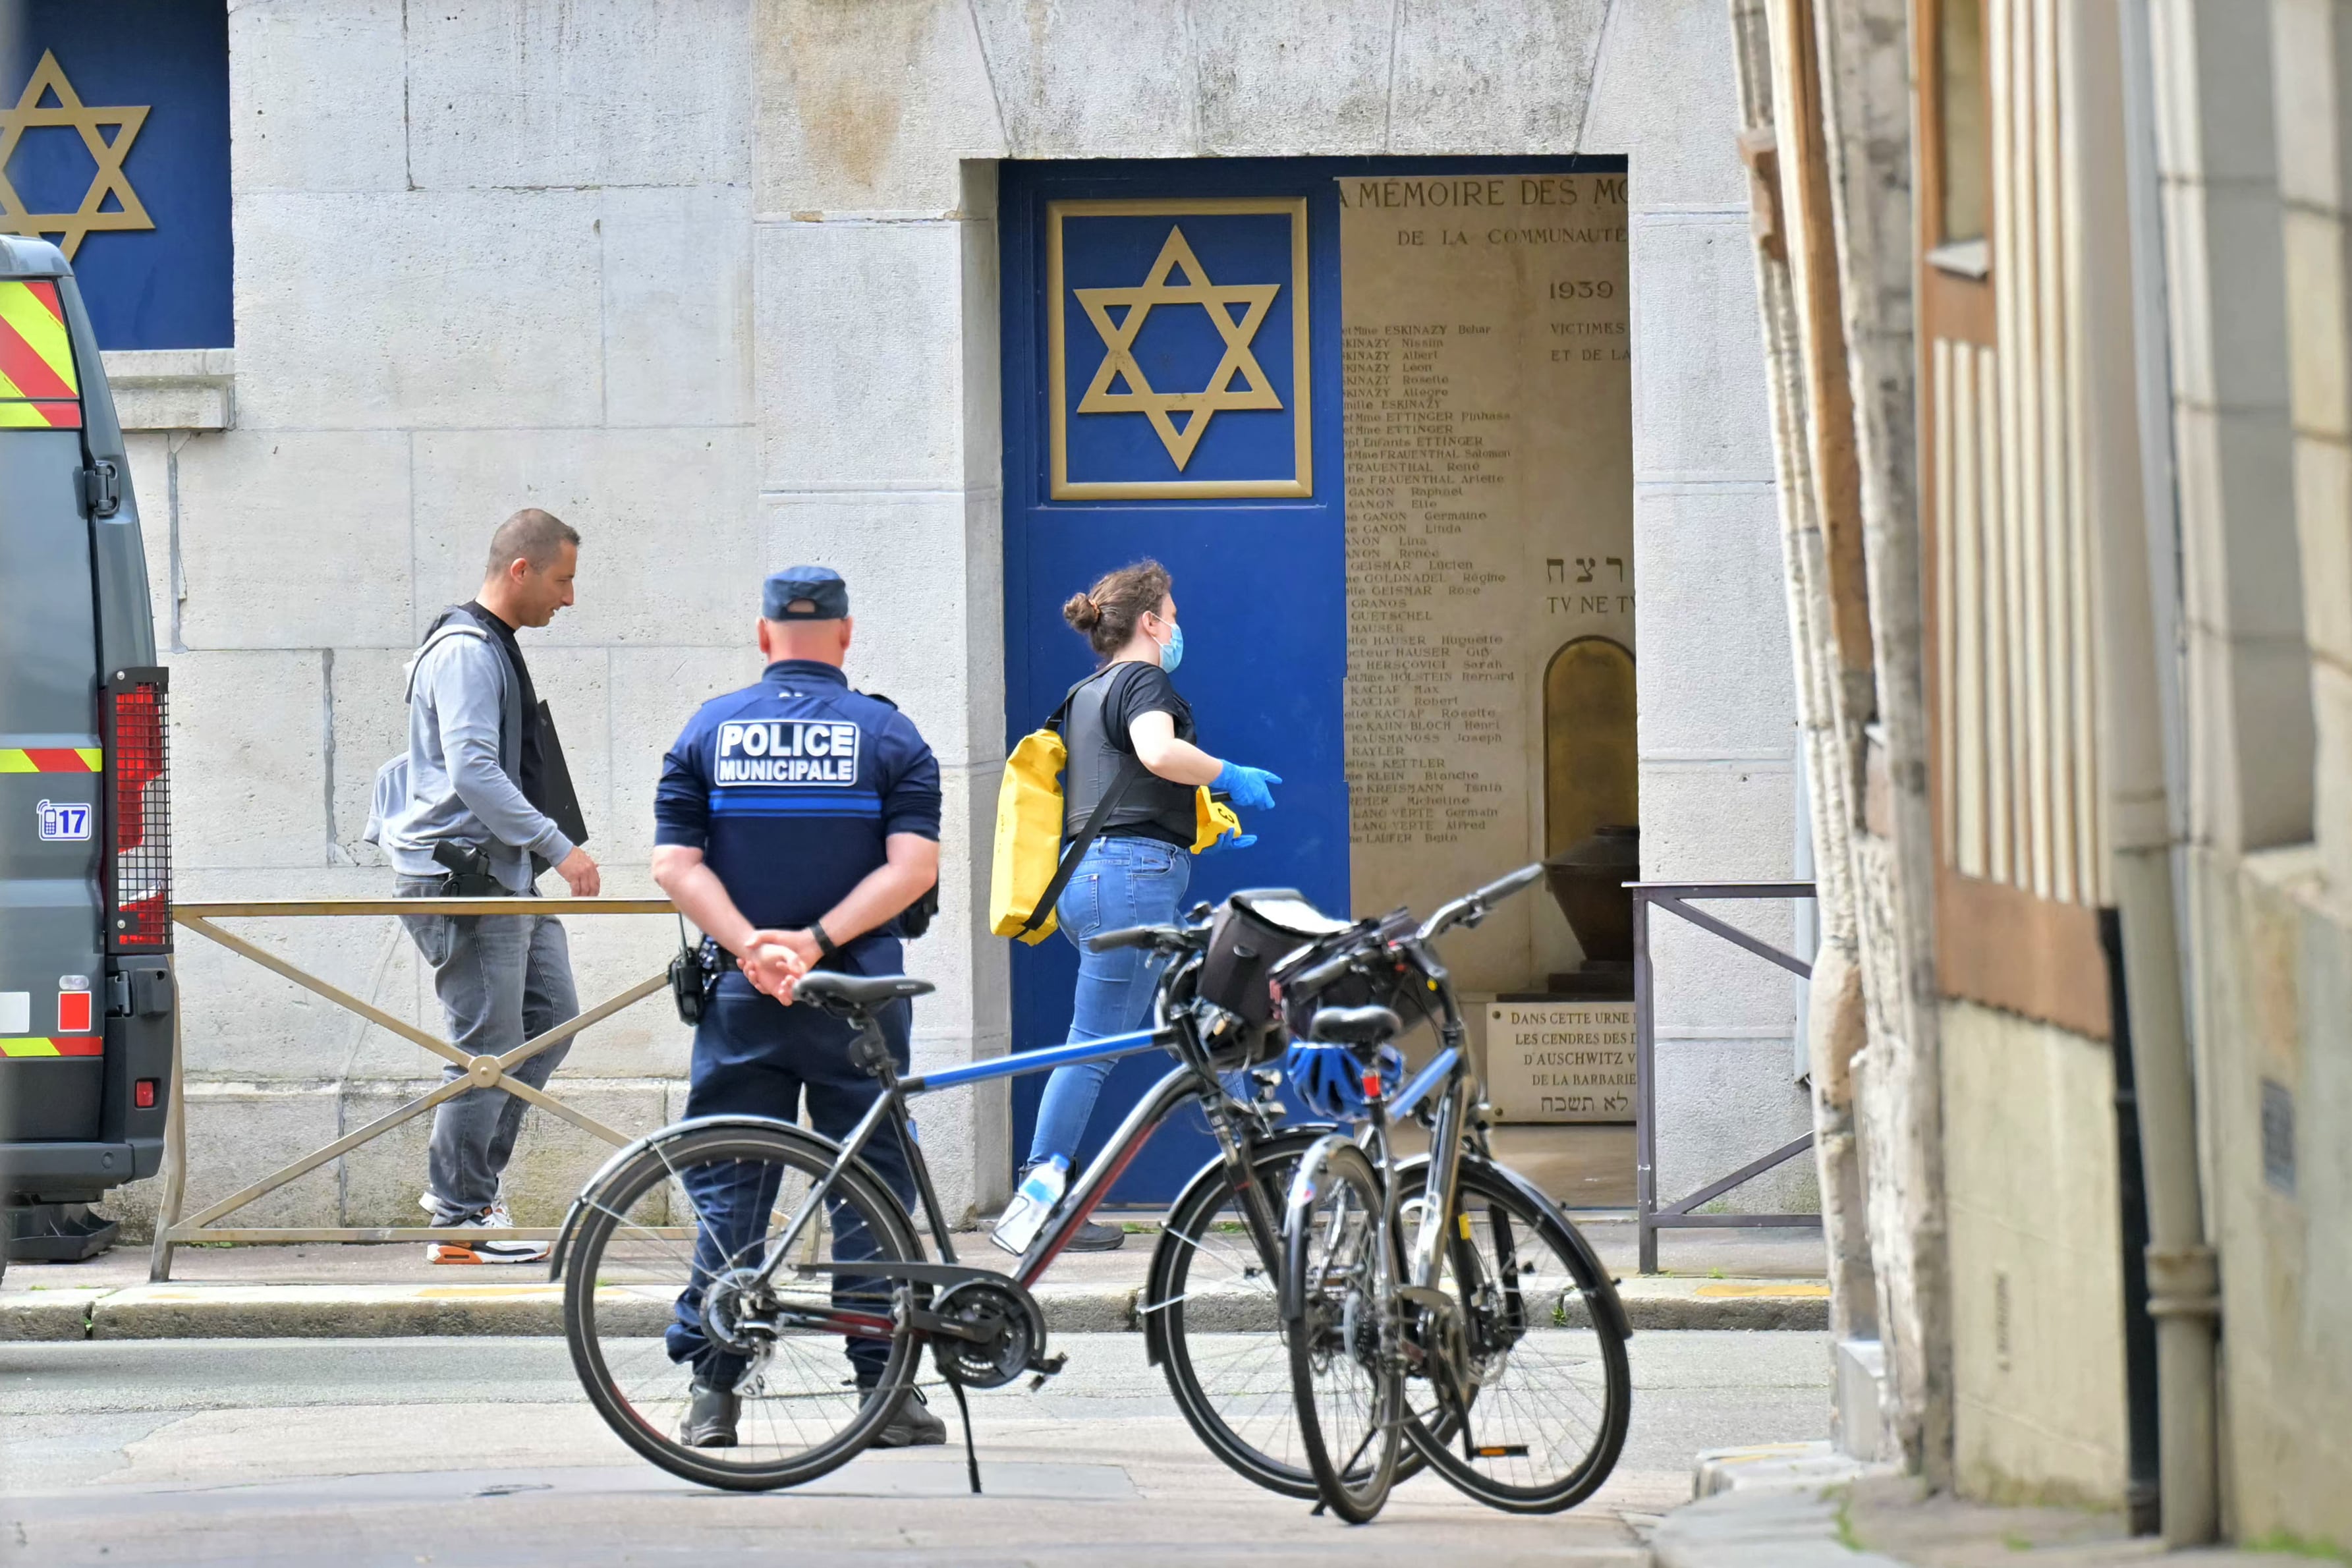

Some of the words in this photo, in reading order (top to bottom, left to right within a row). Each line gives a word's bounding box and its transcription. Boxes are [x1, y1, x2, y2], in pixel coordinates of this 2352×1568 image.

[1360, 178, 1504, 208] MÉMOIRE
[1521, 179, 1577, 205] DES
[1397, 230, 1424, 246] DE
[1442, 229, 1469, 246] LA
[1550, 280, 1613, 298] 1939
[1385, 325, 1447, 335] ESKINAZY
[1550, 322, 1625, 335] VICTIMES
[1402, 350, 1438, 360] Albert
[1551, 349, 1569, 362] ET
[1582, 349, 1602, 361] DE
[1382, 399, 1440, 409] ESKINAZY
[1387, 412, 1453, 422] ETTINGER
[1387, 425, 1453, 435] ETTINGER
[1364, 437, 1411, 447] Enfants
[1417, 436, 1483, 447] ETTINGER
[1381, 450, 1460, 459] FRAUENTHAL
[1348, 462, 1433, 472] FRAUENTHAL
[1370, 475, 1455, 485] FRAUENTHAL
[1462, 474, 1505, 484] Arlette
[1349, 487, 1394, 497] GANON
[1349, 500, 1394, 509] GANON
[1363, 512, 1407, 521] GANON
[1424, 511, 1487, 520] Germaine
[1363, 524, 1407, 534] GANON
[1426, 524, 1462, 534] Linda
[1399, 536, 1427, 546] Lina
[1351, 561, 1412, 570] GEISMAR
[1430, 560, 1473, 570] Lucien
[1364, 574, 1446, 583] GOLDNADEL
[1372, 586, 1432, 596] GEISMAR
[1449, 586, 1480, 596] Rose
[1547, 596, 1571, 613] TV
[1581, 596, 1608, 613] NE
[1351, 611, 1432, 621] GUETSCHEL
[1351, 624, 1404, 633] HAUSER
[1374, 636, 1426, 646] HAUSER
[1397, 648, 1450, 658] HAUSER
[1463, 659, 1502, 669] Sarah
[1391, 673, 1452, 683] HOLSTEIN
[1414, 685, 1439, 694] Max
[1414, 696, 1457, 706] Robert
[1411, 721, 1451, 731] BLOCH
[1465, 720, 1500, 731] Henri
[721, 723, 854, 757] POLICE
[1455, 733, 1502, 744] Joseph
[1353, 746, 1404, 756] KAYLER
[1383, 758, 1445, 769] KETTLER
[719, 759, 853, 781] MUNICIPALE
[1367, 771, 1404, 781] KLEIN
[1425, 771, 1478, 781] Blanche
[1368, 784, 1443, 794] KREISMANN
[1408, 796, 1470, 806] Micheline
[1446, 808, 1498, 818] Germain
[59, 810, 86, 833] 17
[1447, 820, 1486, 831] Alfred
[1366, 833, 1412, 843] LAUFER
[1511, 1012, 1546, 1024] DANS
[1550, 1012, 1591, 1024] CETTE
[1596, 1012, 1630, 1024] URNE
[1515, 1033, 1538, 1045] LES
[1542, 1033, 1600, 1044] CENDRES
[1604, 1032, 1627, 1044] DES
[1532, 1074, 1548, 1086] DE
[1553, 1074, 1568, 1086] LA
[1573, 1073, 1637, 1086] BARBARIE
[1541, 1096, 1594, 1112] תשכח
[1604, 1090, 1629, 1111] לא
